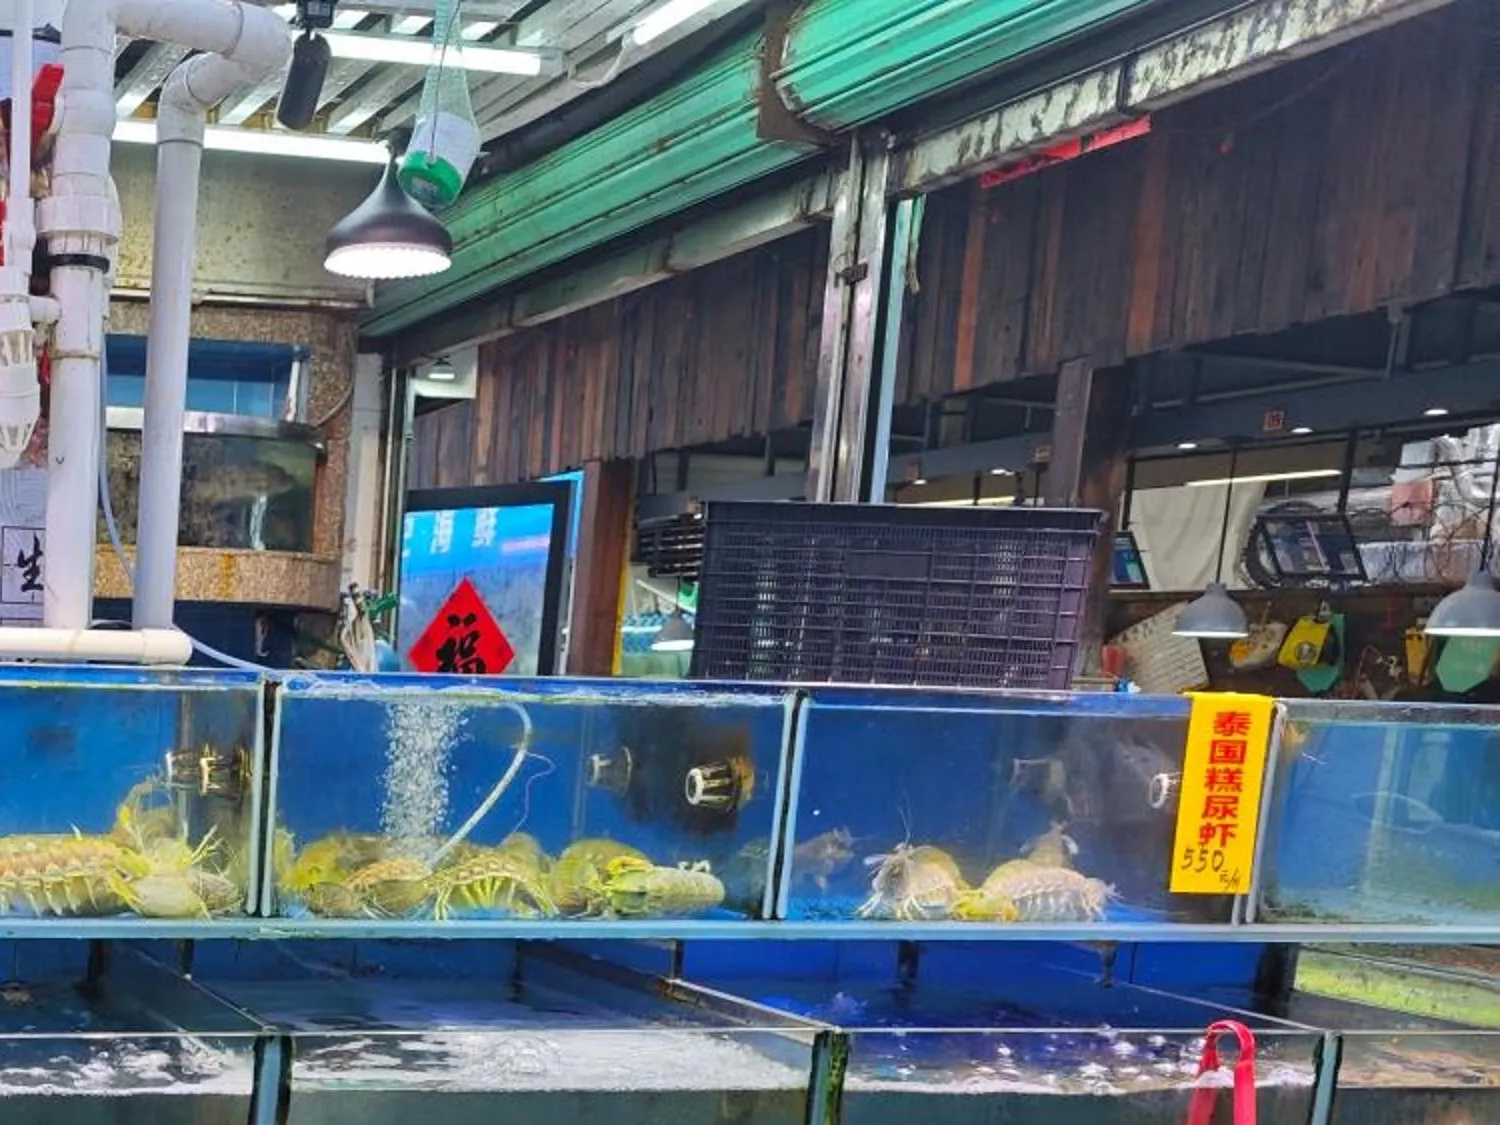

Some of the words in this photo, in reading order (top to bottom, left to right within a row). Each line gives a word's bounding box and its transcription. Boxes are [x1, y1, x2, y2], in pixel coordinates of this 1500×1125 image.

[1198, 711, 1252, 849] 泰国糕尿虾
